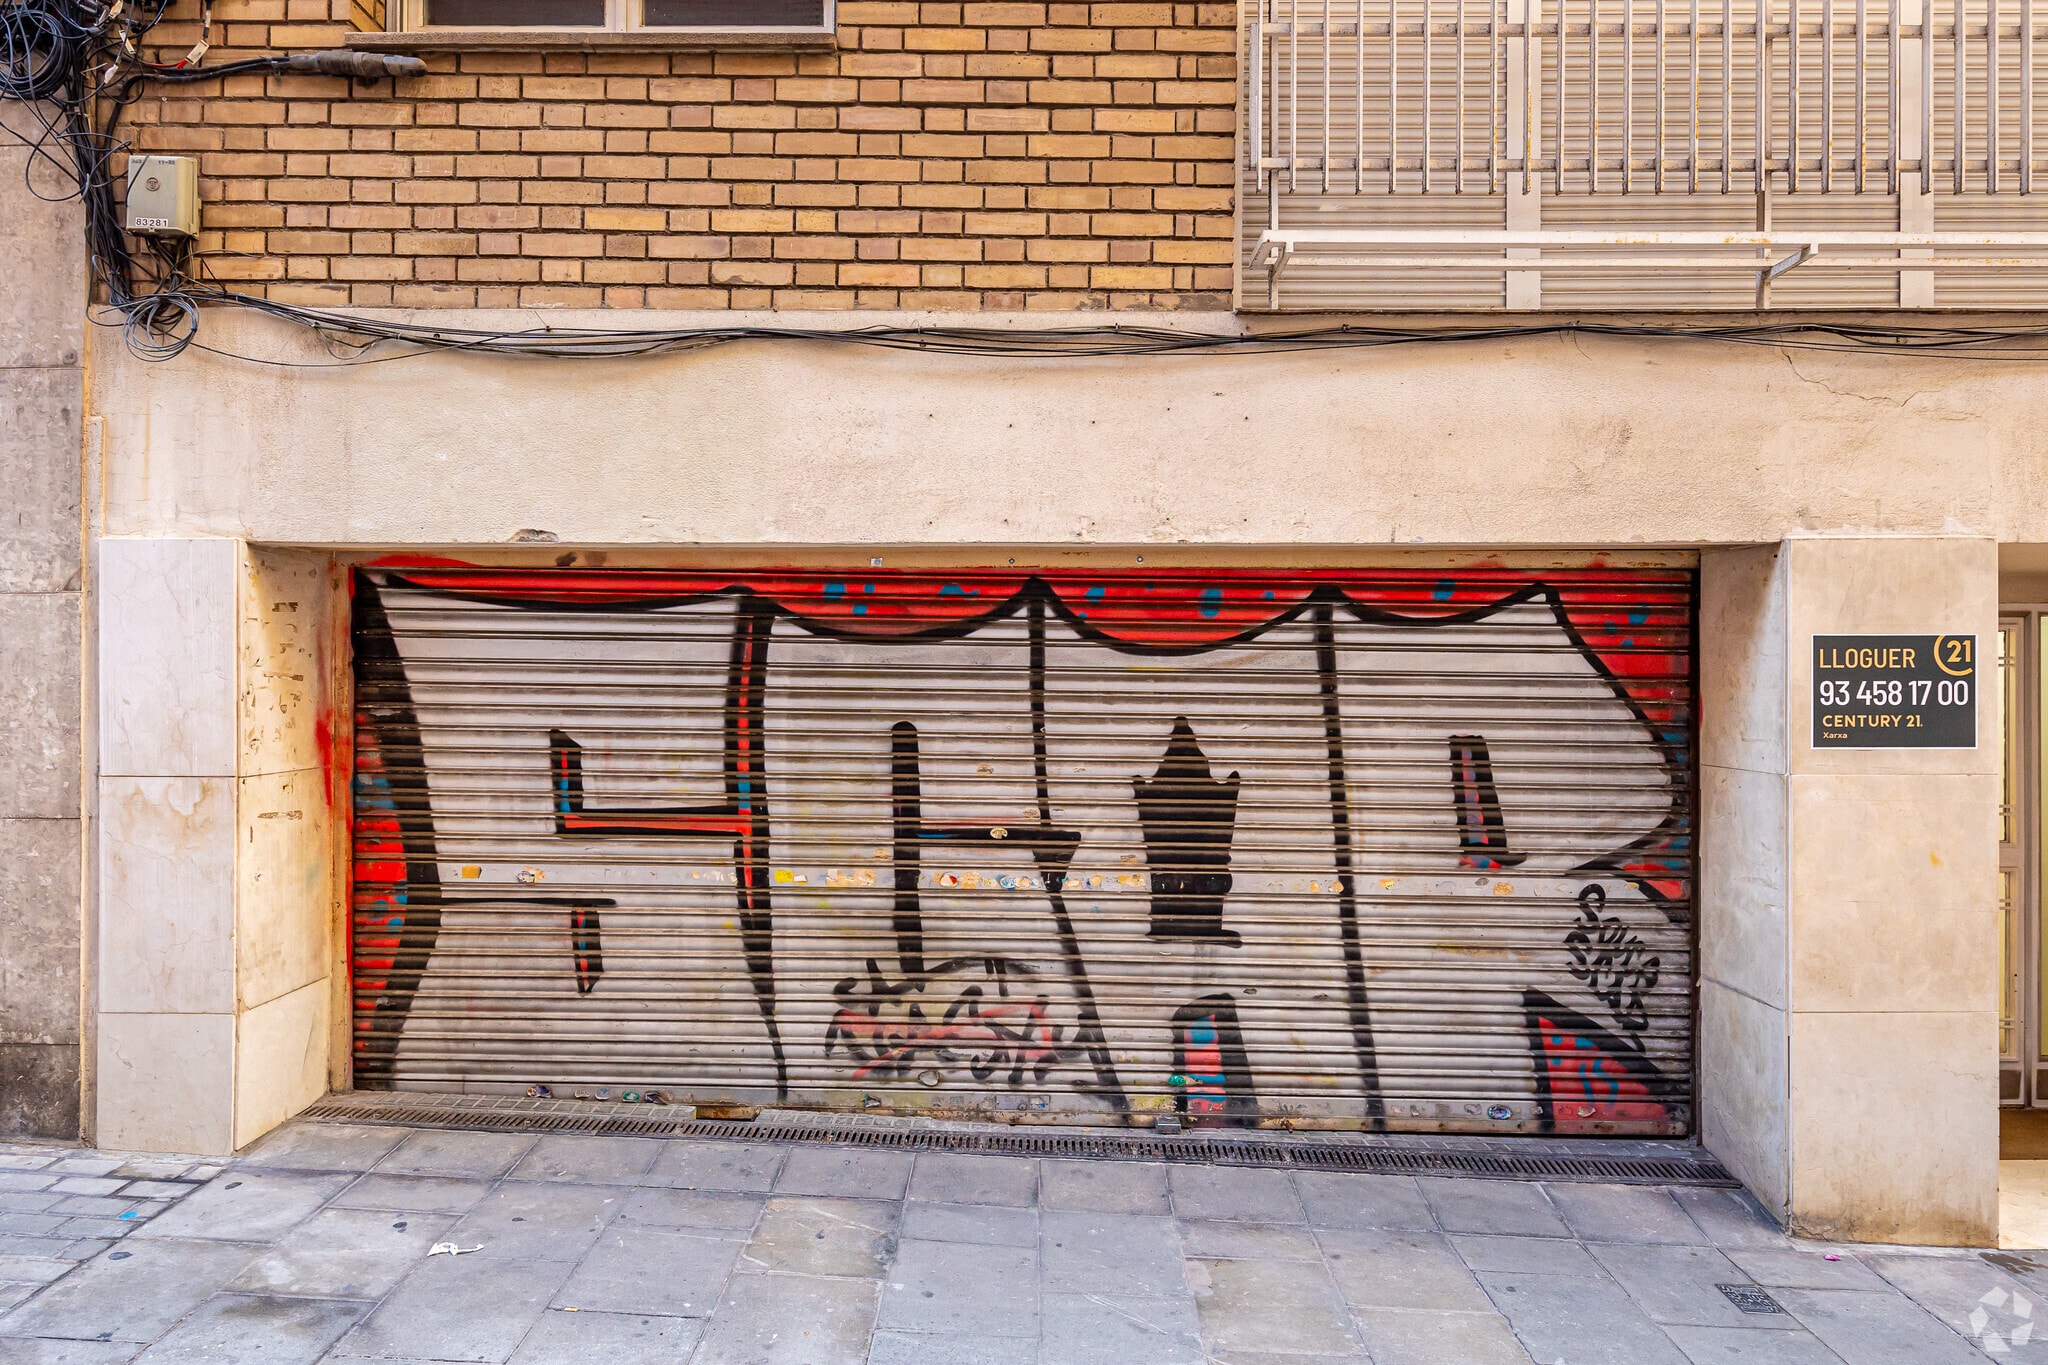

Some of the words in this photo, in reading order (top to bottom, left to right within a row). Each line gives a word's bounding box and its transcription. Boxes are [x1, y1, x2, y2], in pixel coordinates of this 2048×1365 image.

[136, 218, 168, 227] 83281
[1819, 648, 1916, 669] LLOGUER
[1946, 640, 1971, 663] 21
[1819, 680, 1850, 706] 93
[1856, 680, 1903, 706] 458
[1908, 680, 1932, 706] 17
[1937, 680, 1969, 706] 00
[1822, 714, 1902, 728] CENTURY
[1822, 731, 1848, 739] Xarxa
